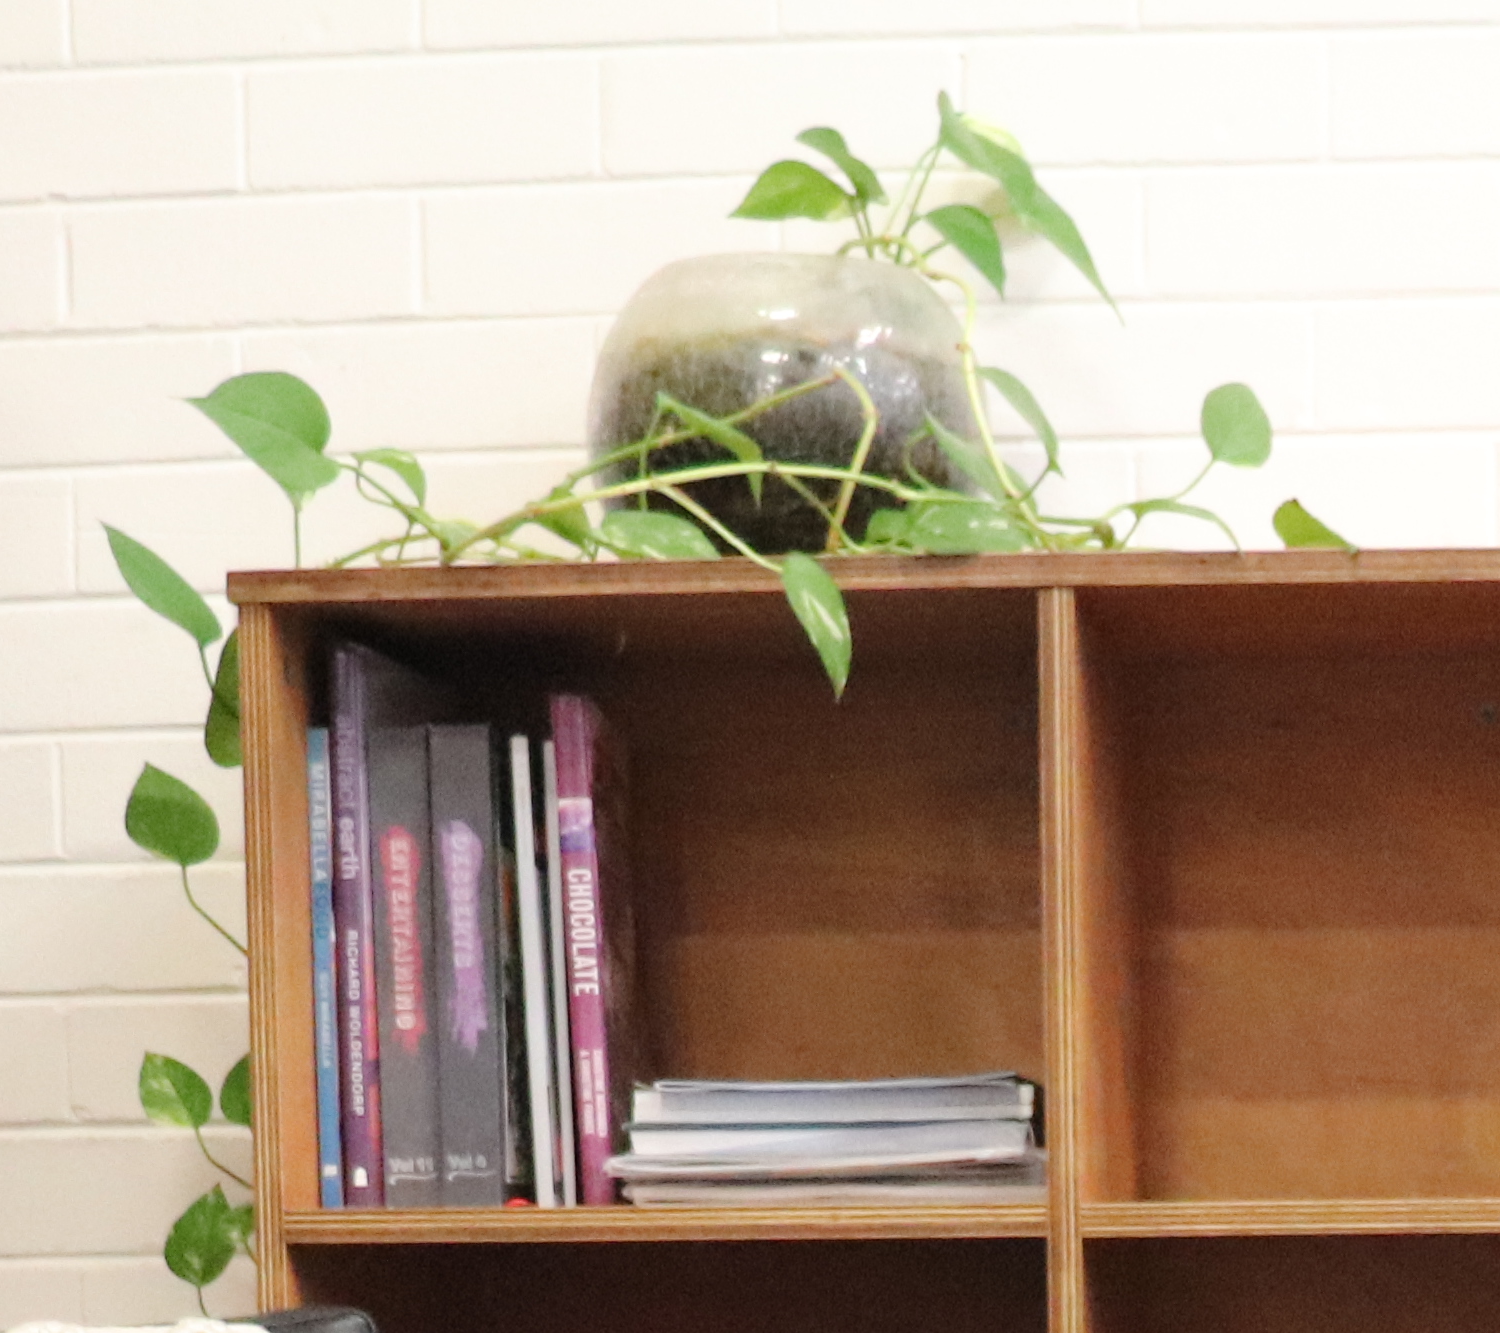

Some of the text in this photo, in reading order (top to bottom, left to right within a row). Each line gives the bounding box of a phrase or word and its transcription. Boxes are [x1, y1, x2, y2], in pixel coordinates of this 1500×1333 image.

[309, 763, 330, 883] MIRABELLA
[338, 816, 357, 881] earth
[347, 929, 361, 1001] RICHARD
[389, 836, 417, 1031] ENTERTAINING
[567, 867, 600, 997] CHOCOLATE
